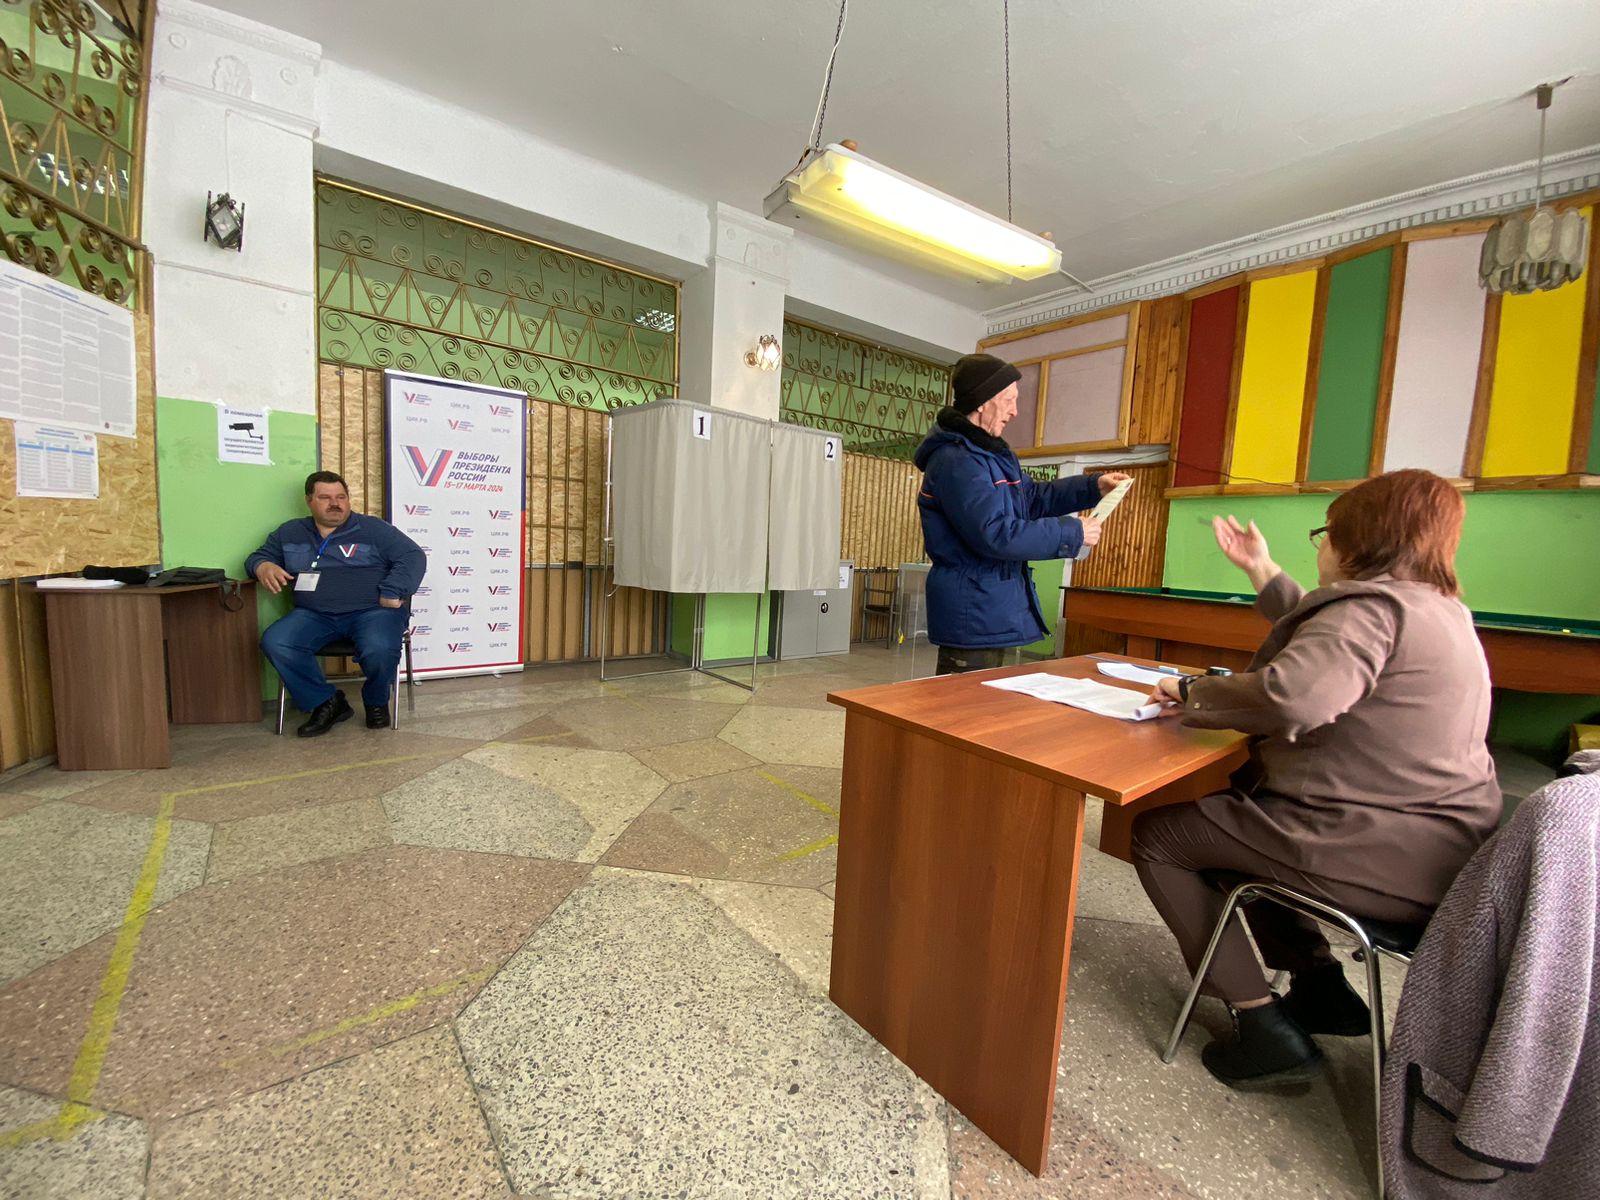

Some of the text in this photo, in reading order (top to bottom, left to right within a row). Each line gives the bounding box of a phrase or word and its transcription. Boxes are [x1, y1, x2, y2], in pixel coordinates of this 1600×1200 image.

[698, 416, 704, 436] 1
[826, 441, 834, 458] 2
[457, 451, 500, 463] ВЫБОРЫ
[452, 461, 512, 475] ПРЕЗИДЕНТА
[447, 471, 487, 482] РОССИИ
[463, 482, 487, 491] МАРТА
[487, 484, 503, 493] 2024
